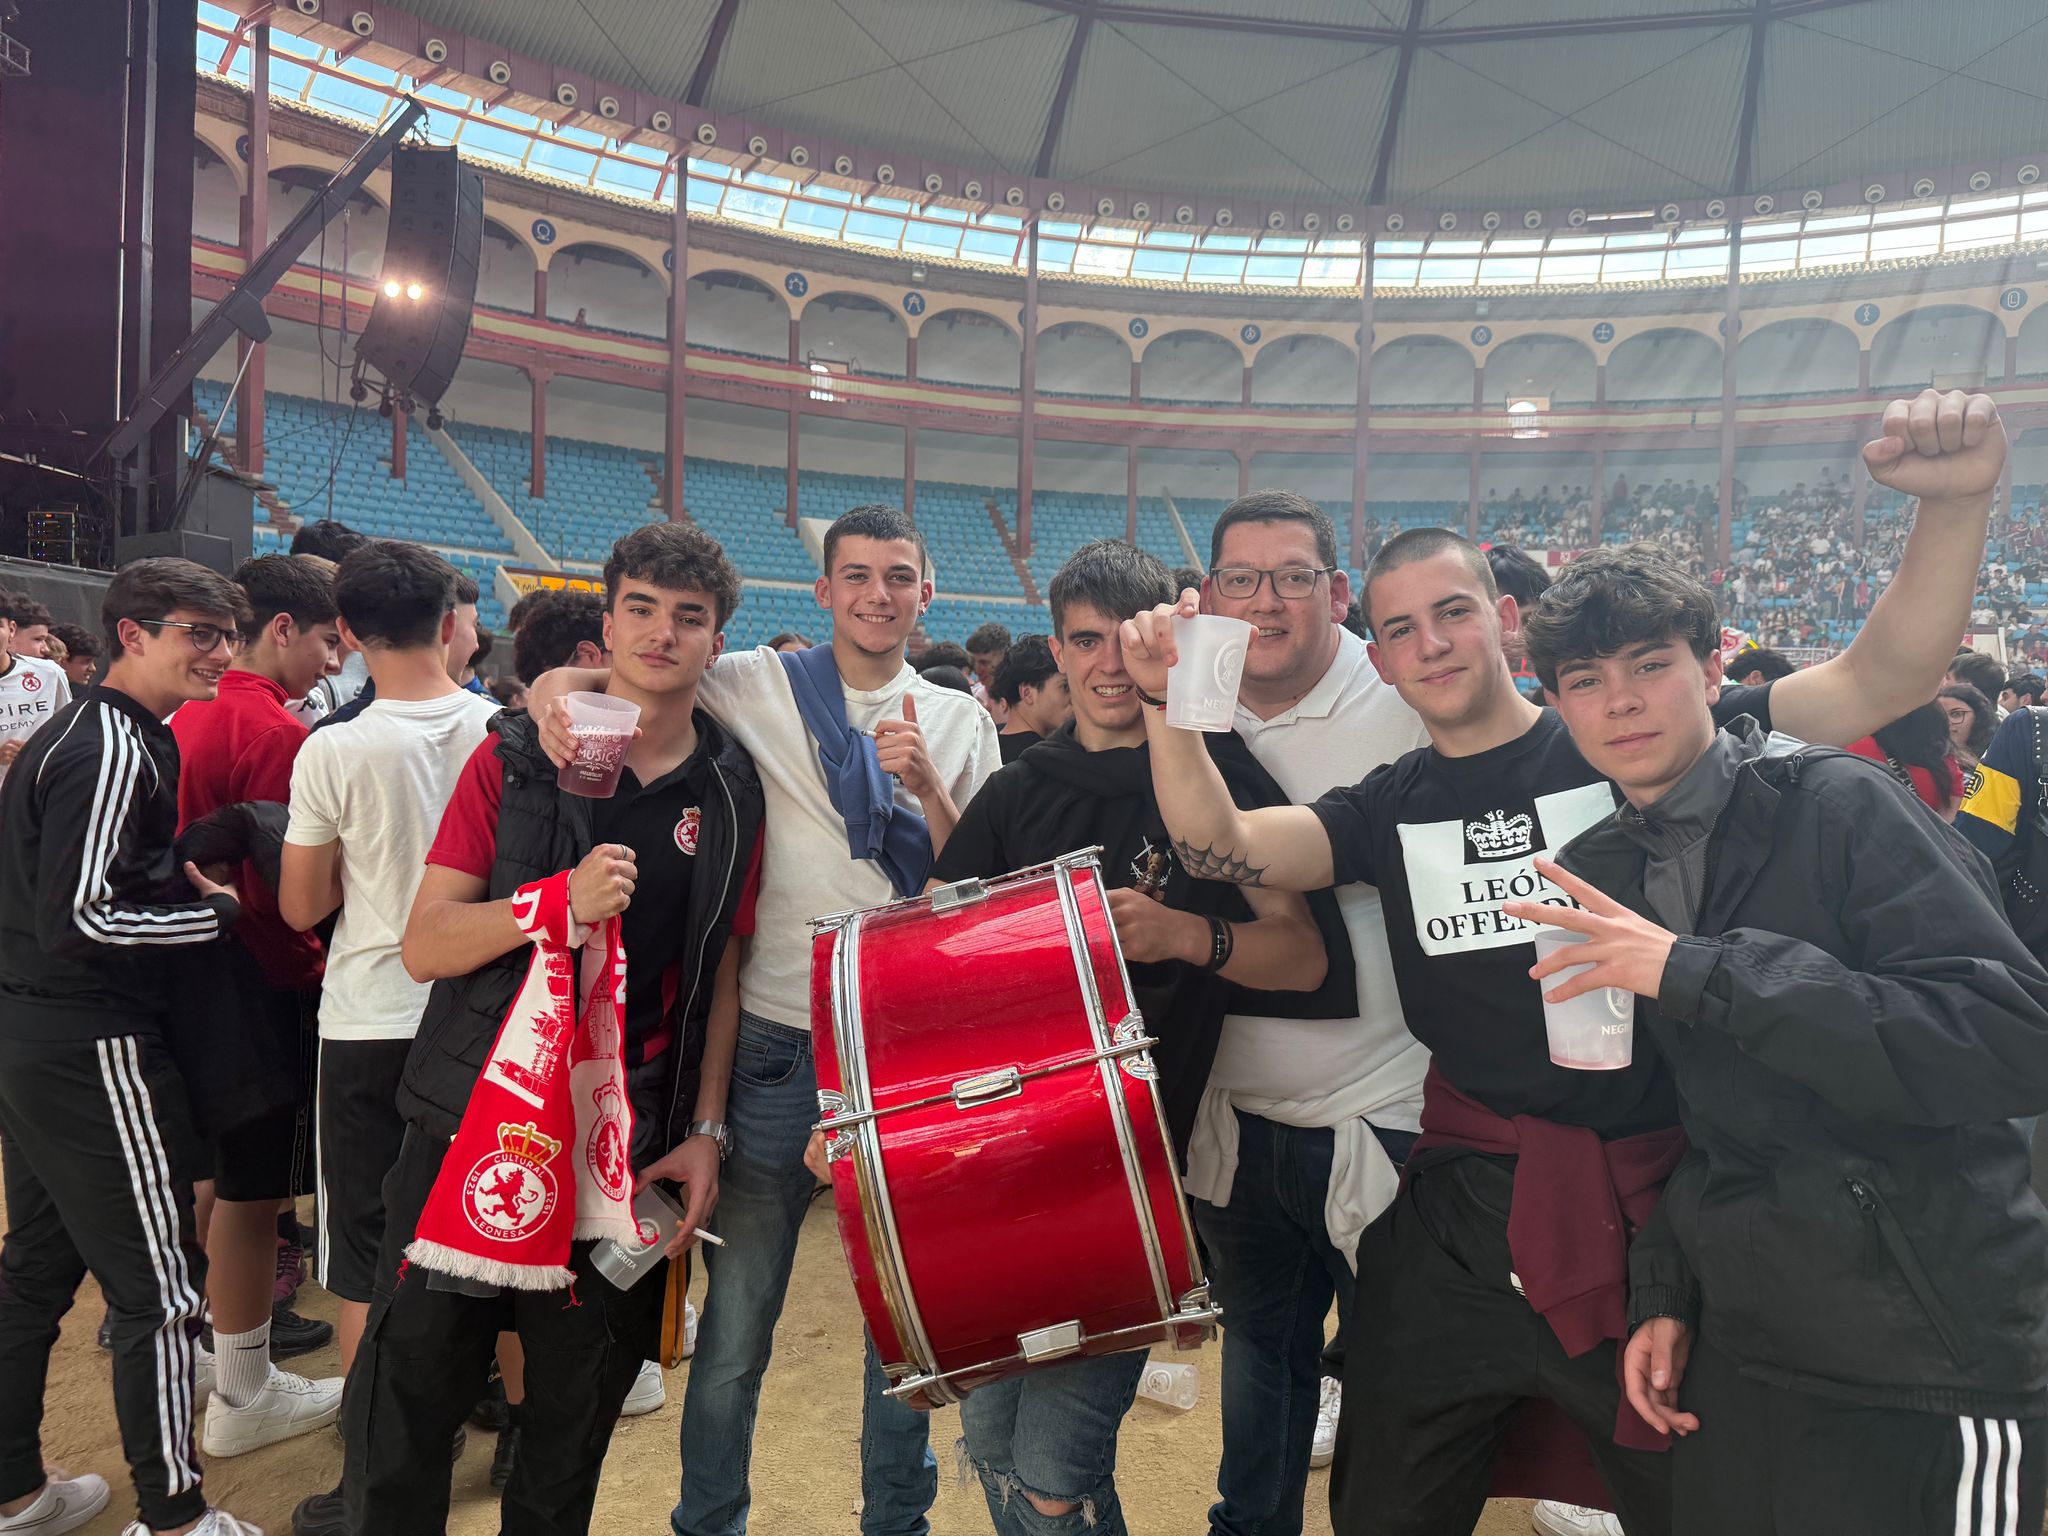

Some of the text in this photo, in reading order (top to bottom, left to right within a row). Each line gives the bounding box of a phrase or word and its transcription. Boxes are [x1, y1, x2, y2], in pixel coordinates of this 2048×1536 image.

[576, 748, 615, 763] MUSIC
[493, 1153, 546, 1179] CULTURAL
[466, 1170, 481, 1195] 1923
[542, 1191, 554, 1215] 1923
[473, 1216, 527, 1238] LEONESA
[609, 1241, 637, 1270] NEGRITA
